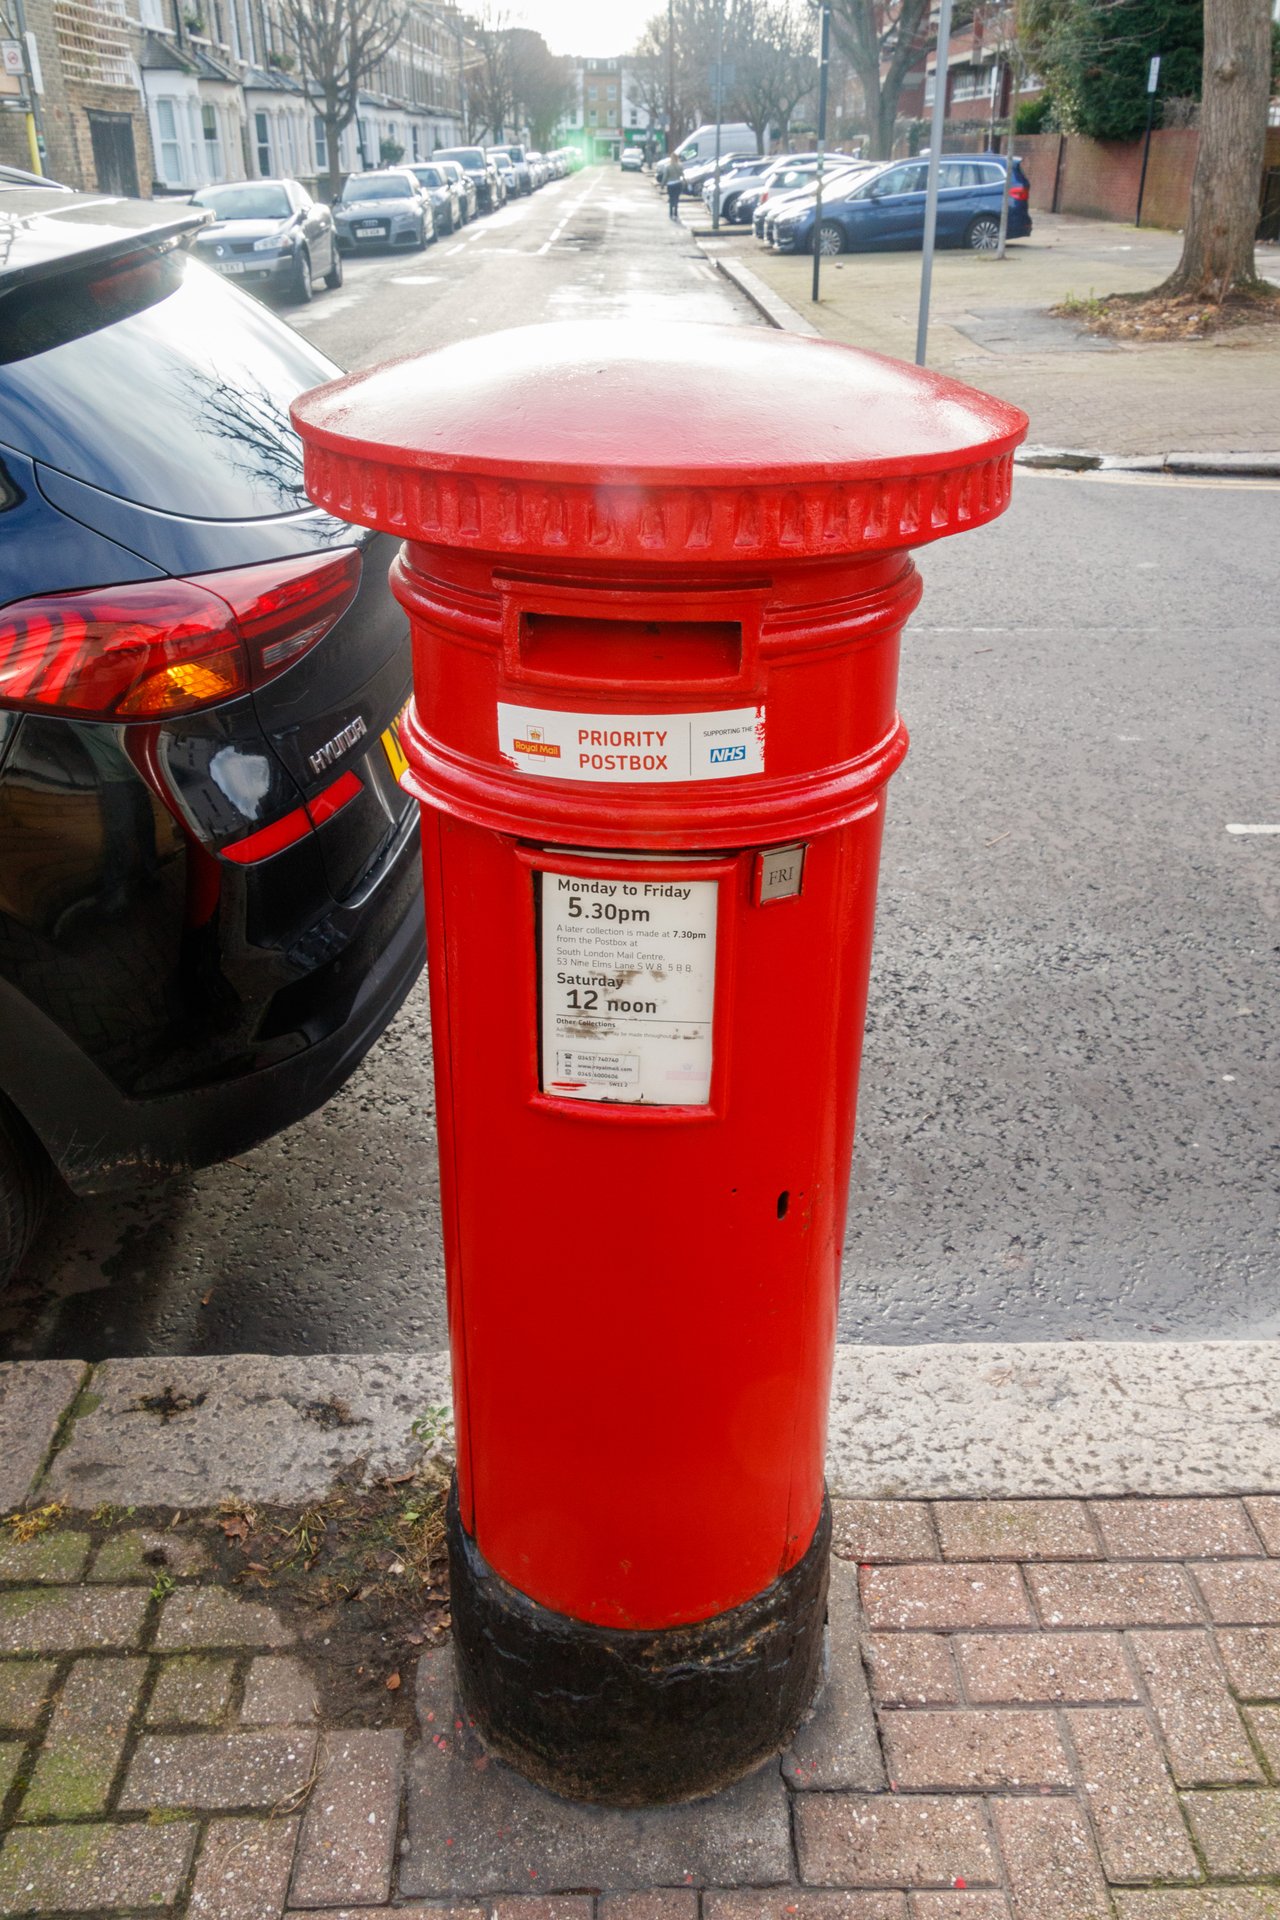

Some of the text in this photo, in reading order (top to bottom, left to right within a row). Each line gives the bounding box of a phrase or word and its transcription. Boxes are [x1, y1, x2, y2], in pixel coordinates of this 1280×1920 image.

[578, 730, 668, 746] PRIORITY
[704, 728, 740, 737] SUPPORTING
[309, 716, 367, 774] HYUNDAI
[515, 741, 558, 755] Royal Mail
[579, 754, 668, 770] POSTBOX
[711, 746, 744, 762] NHS
[769, 866, 794, 886] FRI
[558, 879, 691, 900] Monday to Friday
[568, 896, 650, 924] 5.30pm
[565, 925, 583, 934] later
[586, 927, 624, 936] collection
[673, 931, 706, 940] 7.30pm
[579, 936, 592, 944] the
[595, 938, 627, 946] Postbox
[556, 947, 581, 956] South
[584, 948, 614, 958] London
[616, 950, 634, 959] Mail
[556, 958, 568, 966] 53
[592, 960, 612, 968] Elms
[614, 962, 635, 970] Lane
[556, 972, 624, 990] Saturday
[566, 989, 657, 1014] 12 noon
[578, 1020, 616, 1028] Collections
